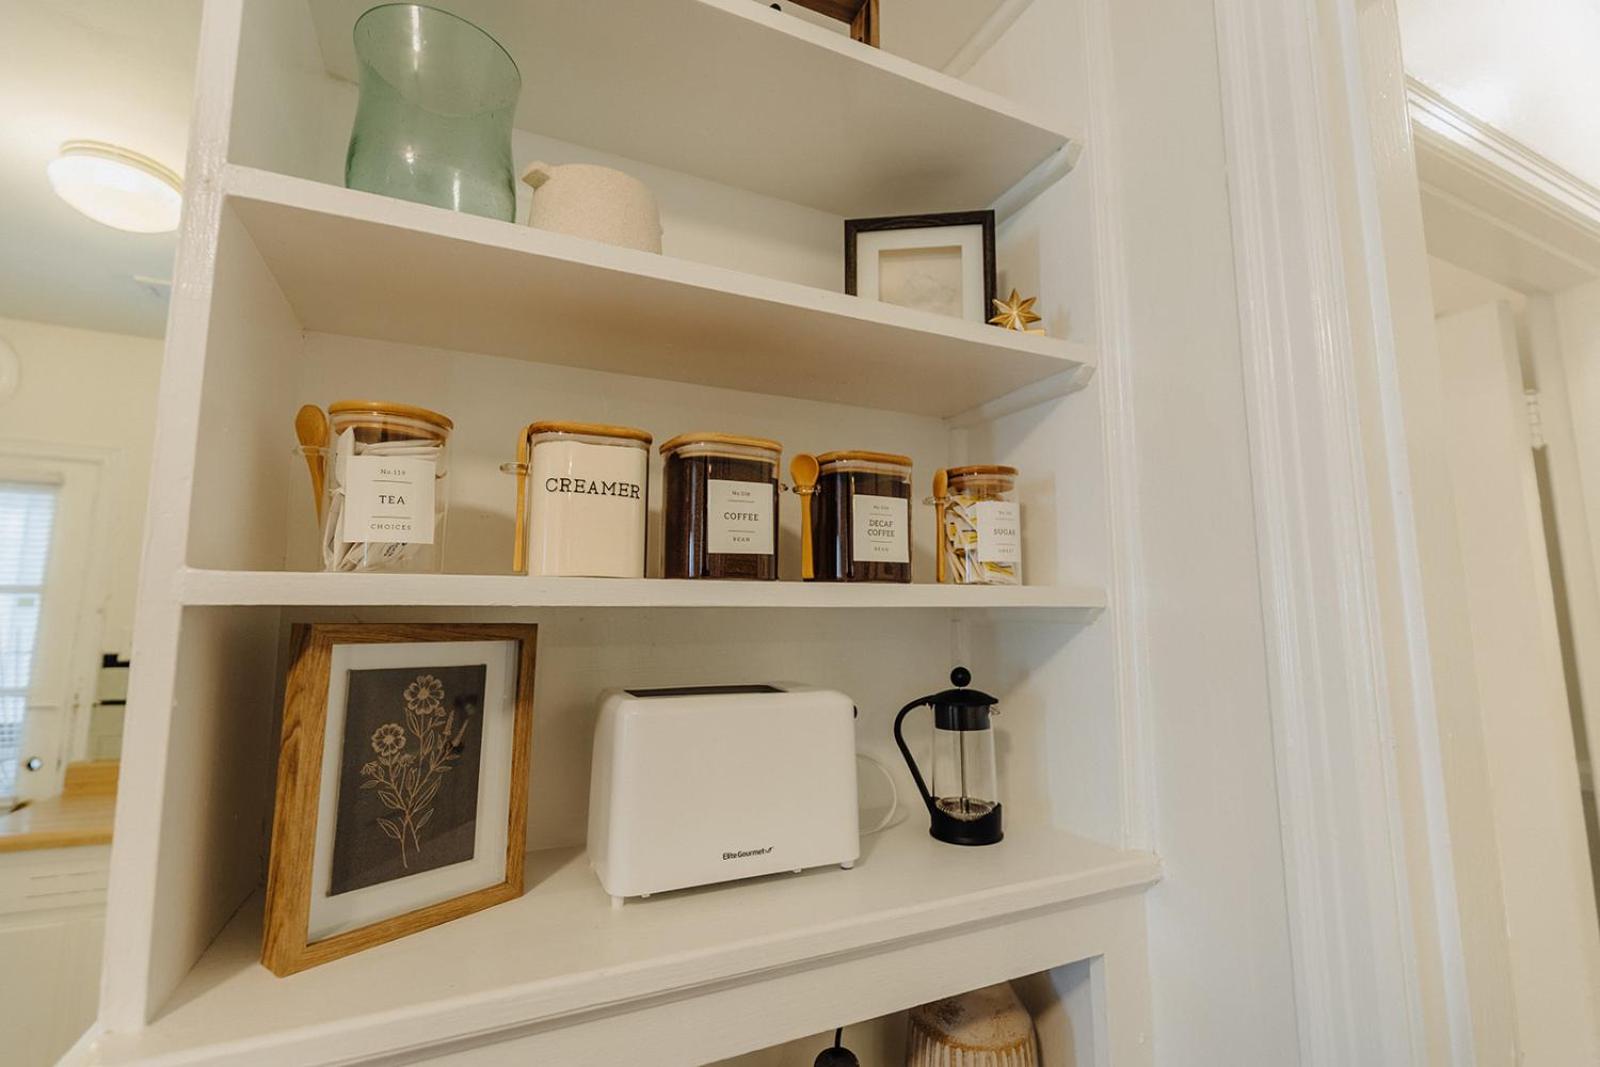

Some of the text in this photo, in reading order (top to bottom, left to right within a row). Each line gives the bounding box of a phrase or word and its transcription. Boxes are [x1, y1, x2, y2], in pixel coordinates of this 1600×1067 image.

[545, 477, 640, 500] CREAMER
[379, 494, 406, 505] TEA
[723, 512, 759, 522] COFFEE
[370, 523, 412, 531] CHOICES
[869, 519, 894, 528] DECAF
[867, 528, 896, 538] COFFEE
